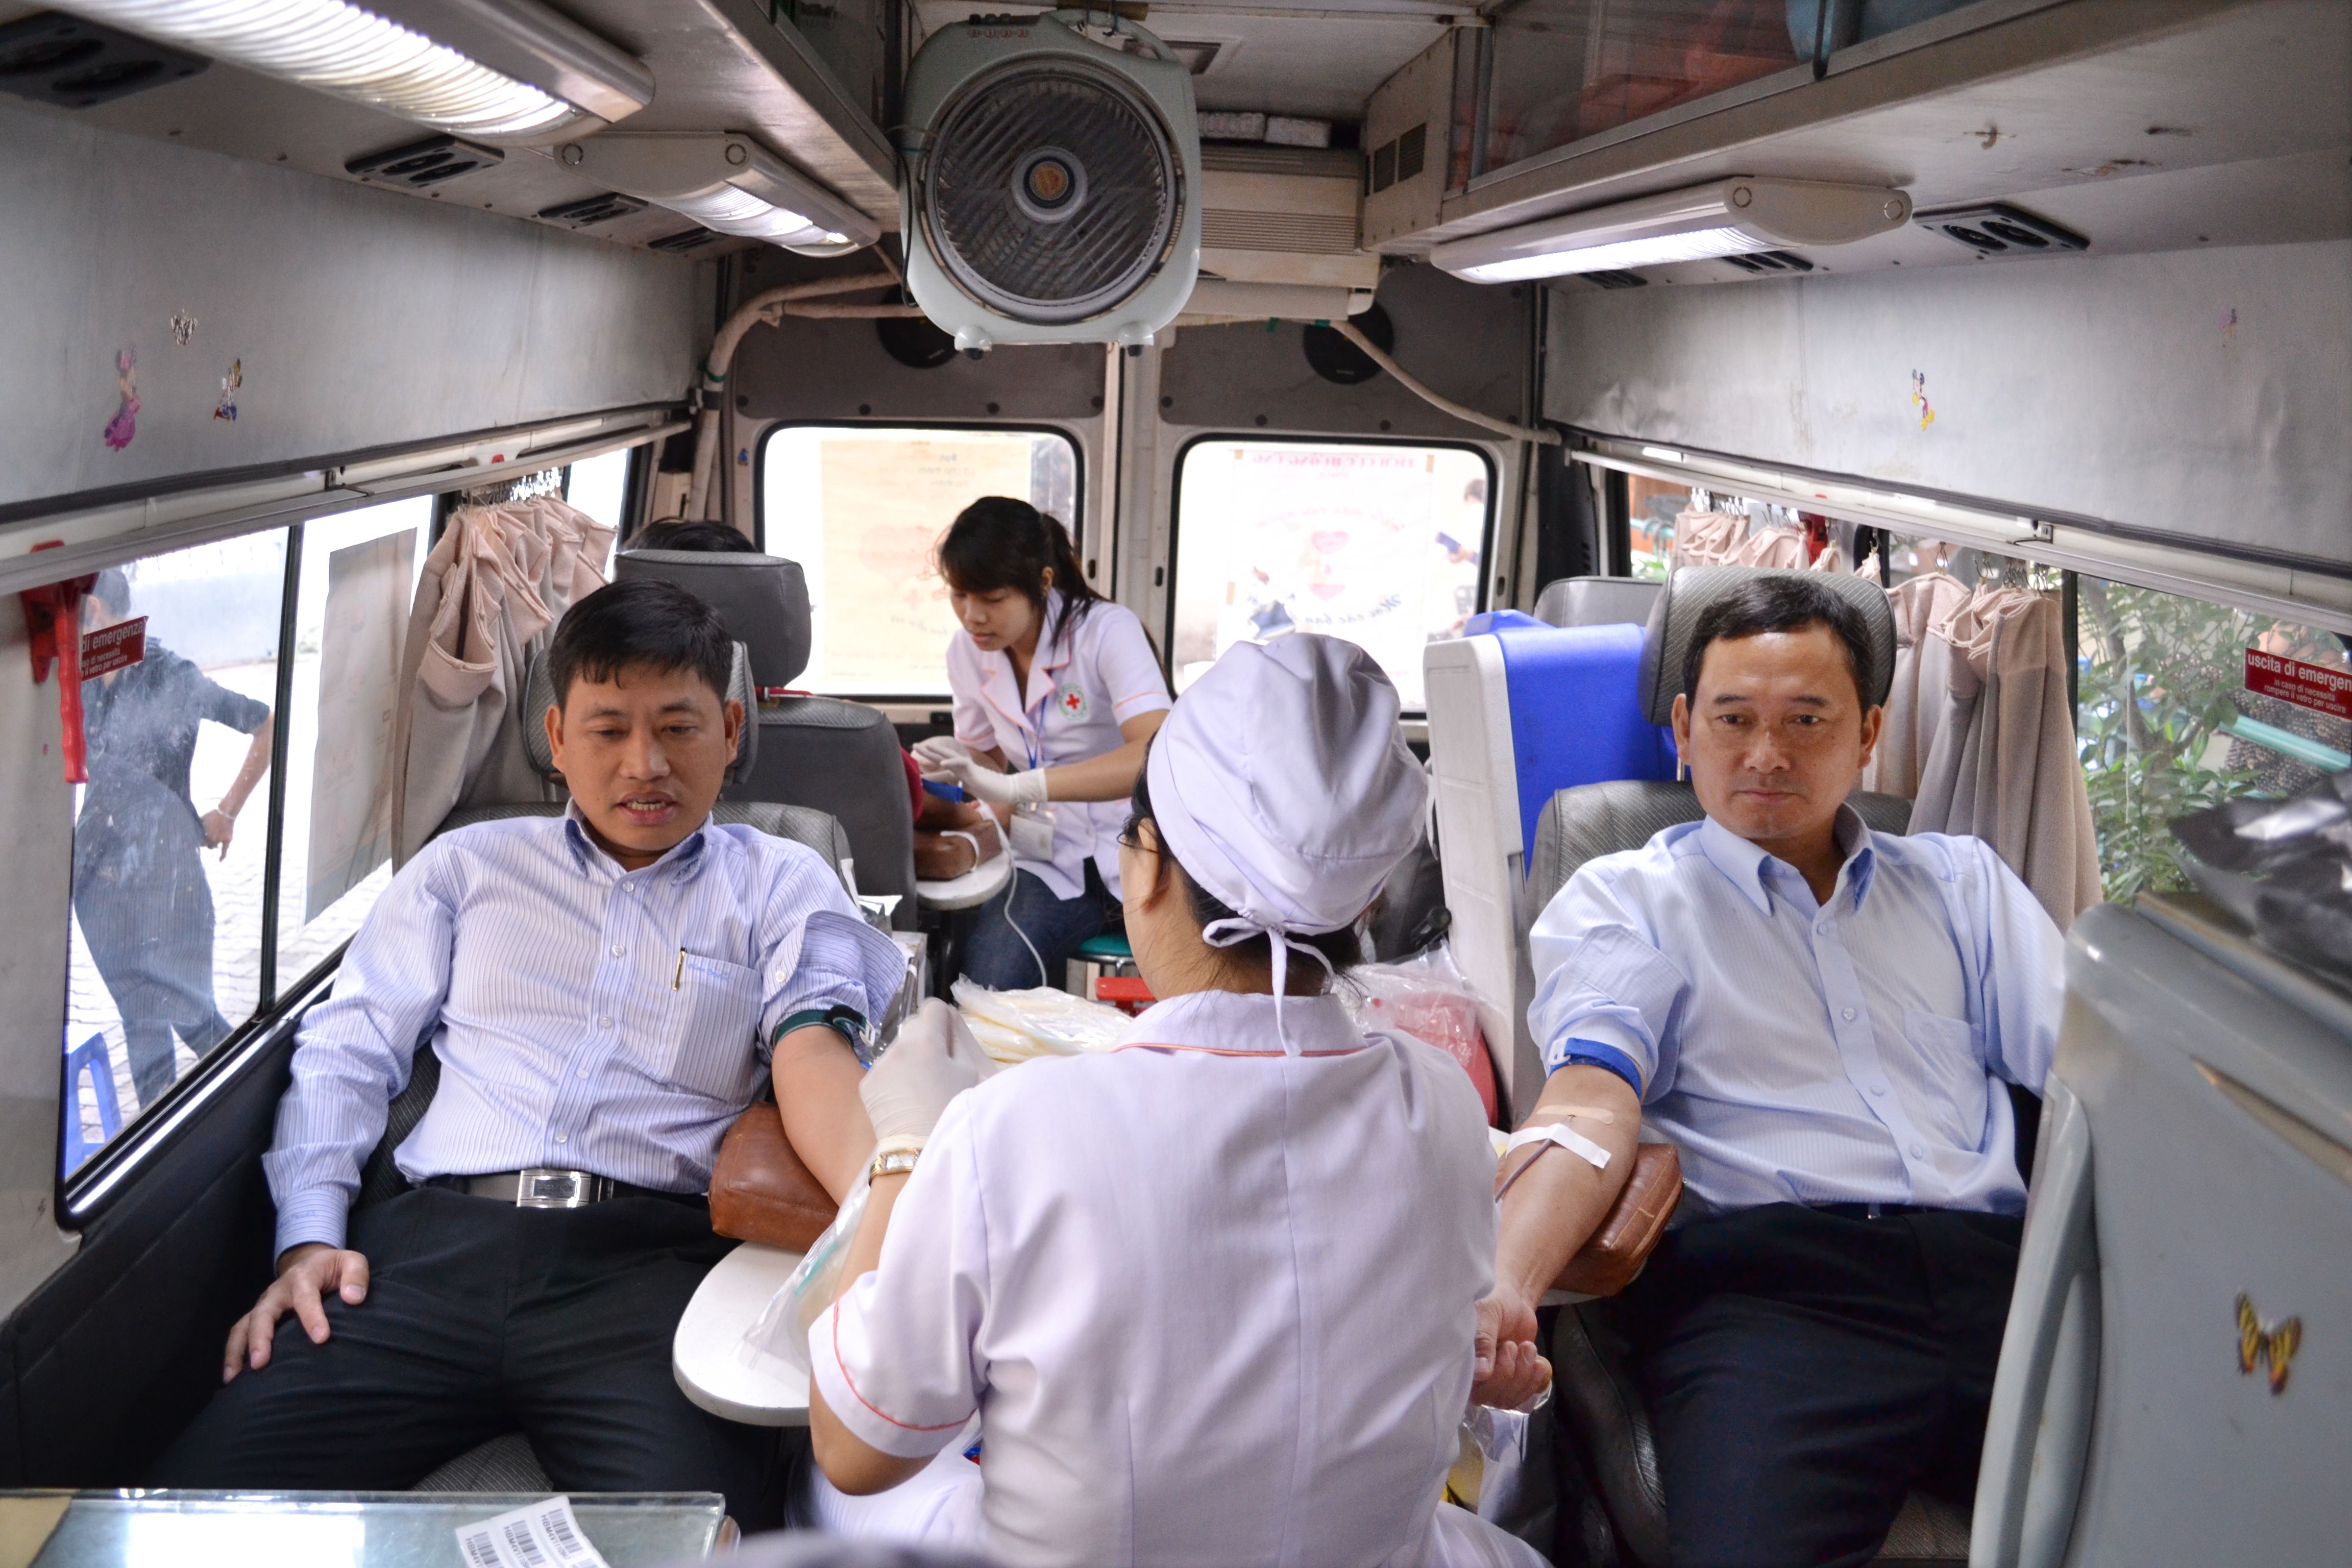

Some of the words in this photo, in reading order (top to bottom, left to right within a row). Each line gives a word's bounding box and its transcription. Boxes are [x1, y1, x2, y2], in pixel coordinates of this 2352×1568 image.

[93, 621, 143, 649] emergenza
[89, 664, 103, 675] vetro
[103, 660, 111, 672] per
[112, 654, 128, 666] uscire
[2248, 654, 2281, 673] uscita
[2284, 661, 2295, 677] di
[2264, 685, 2290, 697] rompere
[2291, 691, 2295, 699] il
[2296, 694, 2312, 704] vetro
[2314, 698, 2324, 707] per
[2325, 701, 2347, 714] uscire
[2274, 677, 2280, 687] in
[2281, 681, 2296, 691] caso
[2297, 684, 2304, 693] di
[2305, 687, 2336, 701] necessità
